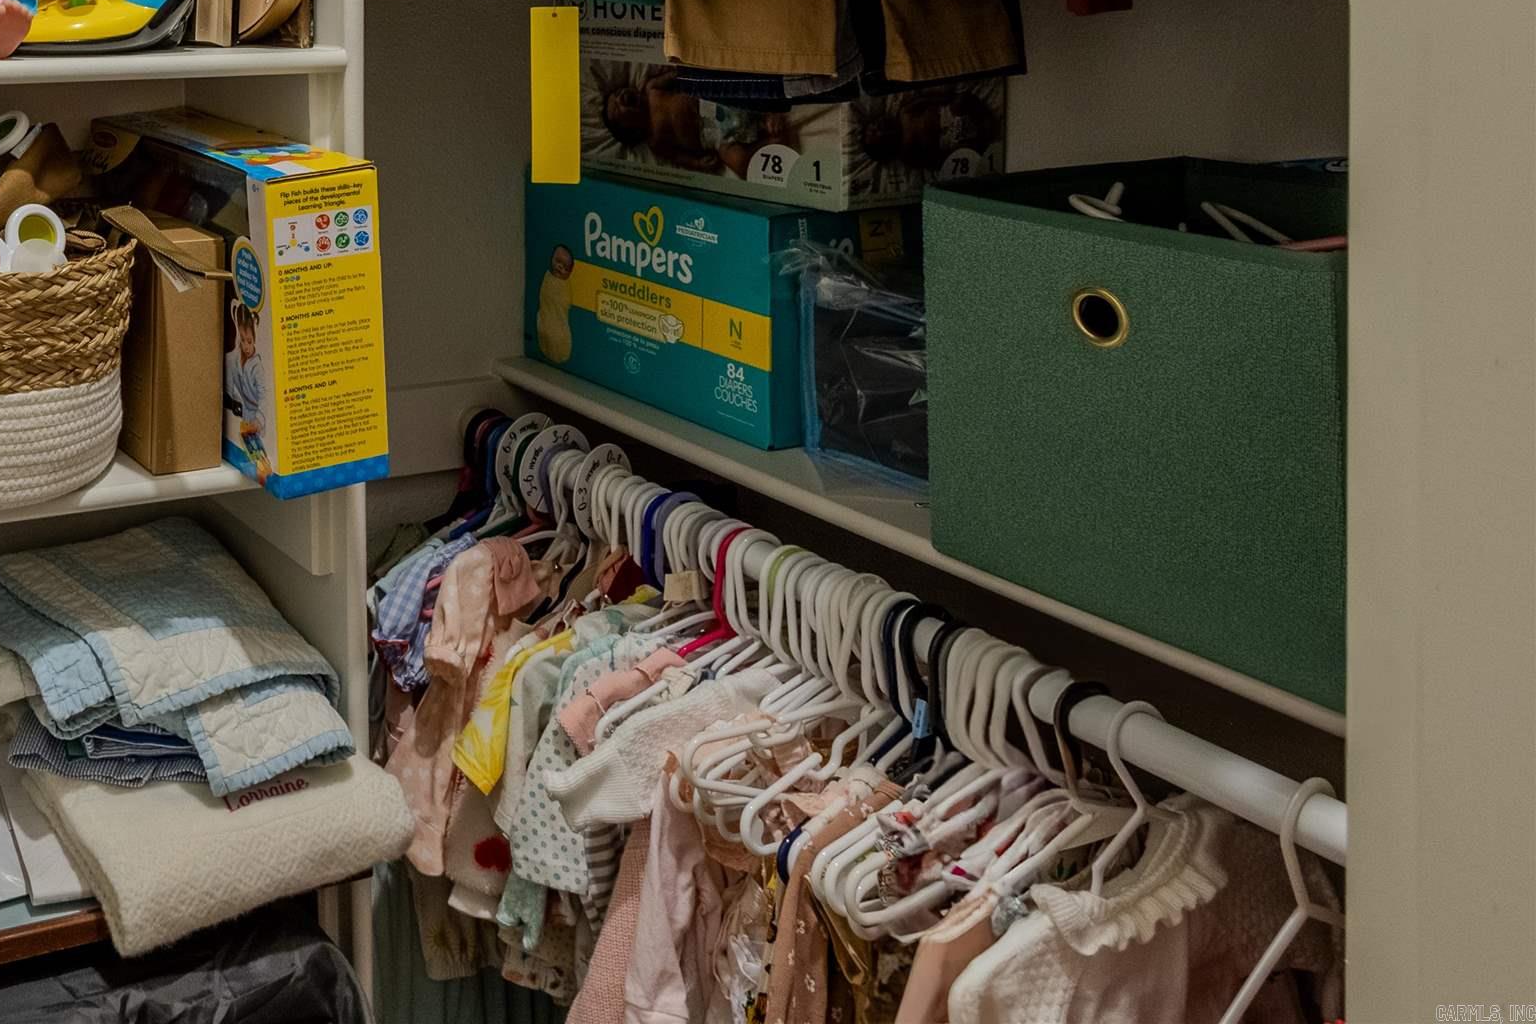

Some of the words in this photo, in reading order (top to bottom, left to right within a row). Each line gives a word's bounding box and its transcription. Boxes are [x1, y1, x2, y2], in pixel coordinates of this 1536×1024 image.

[593, 0, 663, 21] HONE
[592, 26, 631, 37] conscious
[760, 153, 783, 174] 78
[813, 160, 821, 182] 1
[951, 158, 969, 174] 78
[584, 211, 693, 284] Pampers
[602, 277, 672, 309] swaddlers
[600, 309, 616, 321] skin
[617, 314, 657, 336] protection
[729, 318, 743, 340] N
[727, 363, 745, 382] 84
[719, 375, 753, 399] DIAPERS
[714, 386, 758, 413] COUCHES
[577, 487, 587, 511] 0-3
[223, 777, 309, 813] Lorraine
